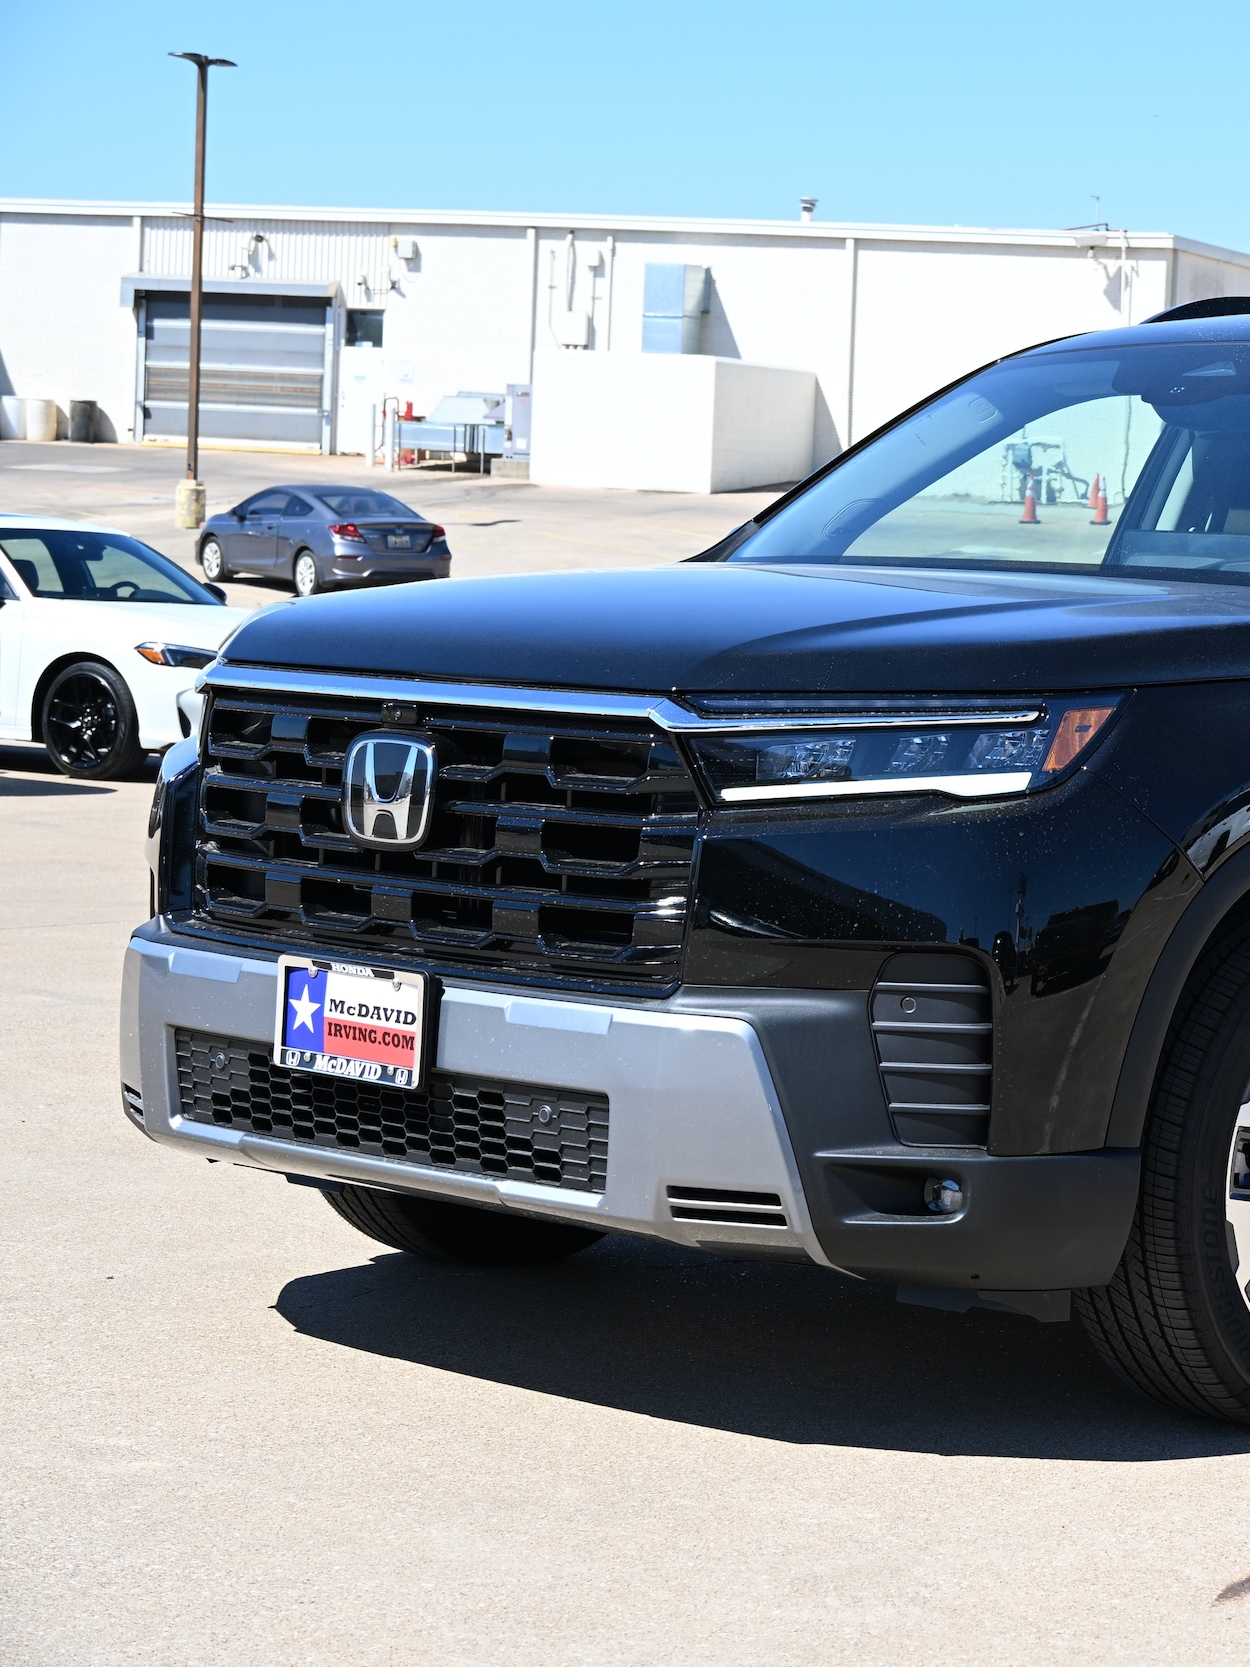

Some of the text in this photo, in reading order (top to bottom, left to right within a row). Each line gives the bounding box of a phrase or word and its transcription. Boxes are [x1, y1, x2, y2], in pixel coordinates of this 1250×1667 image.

[331, 963, 374, 977] HONDA
[329, 998, 417, 1026] McDAVID
[327, 1022, 416, 1051] IRVING.COM
[313, 1054, 382, 1080] McDAVID
